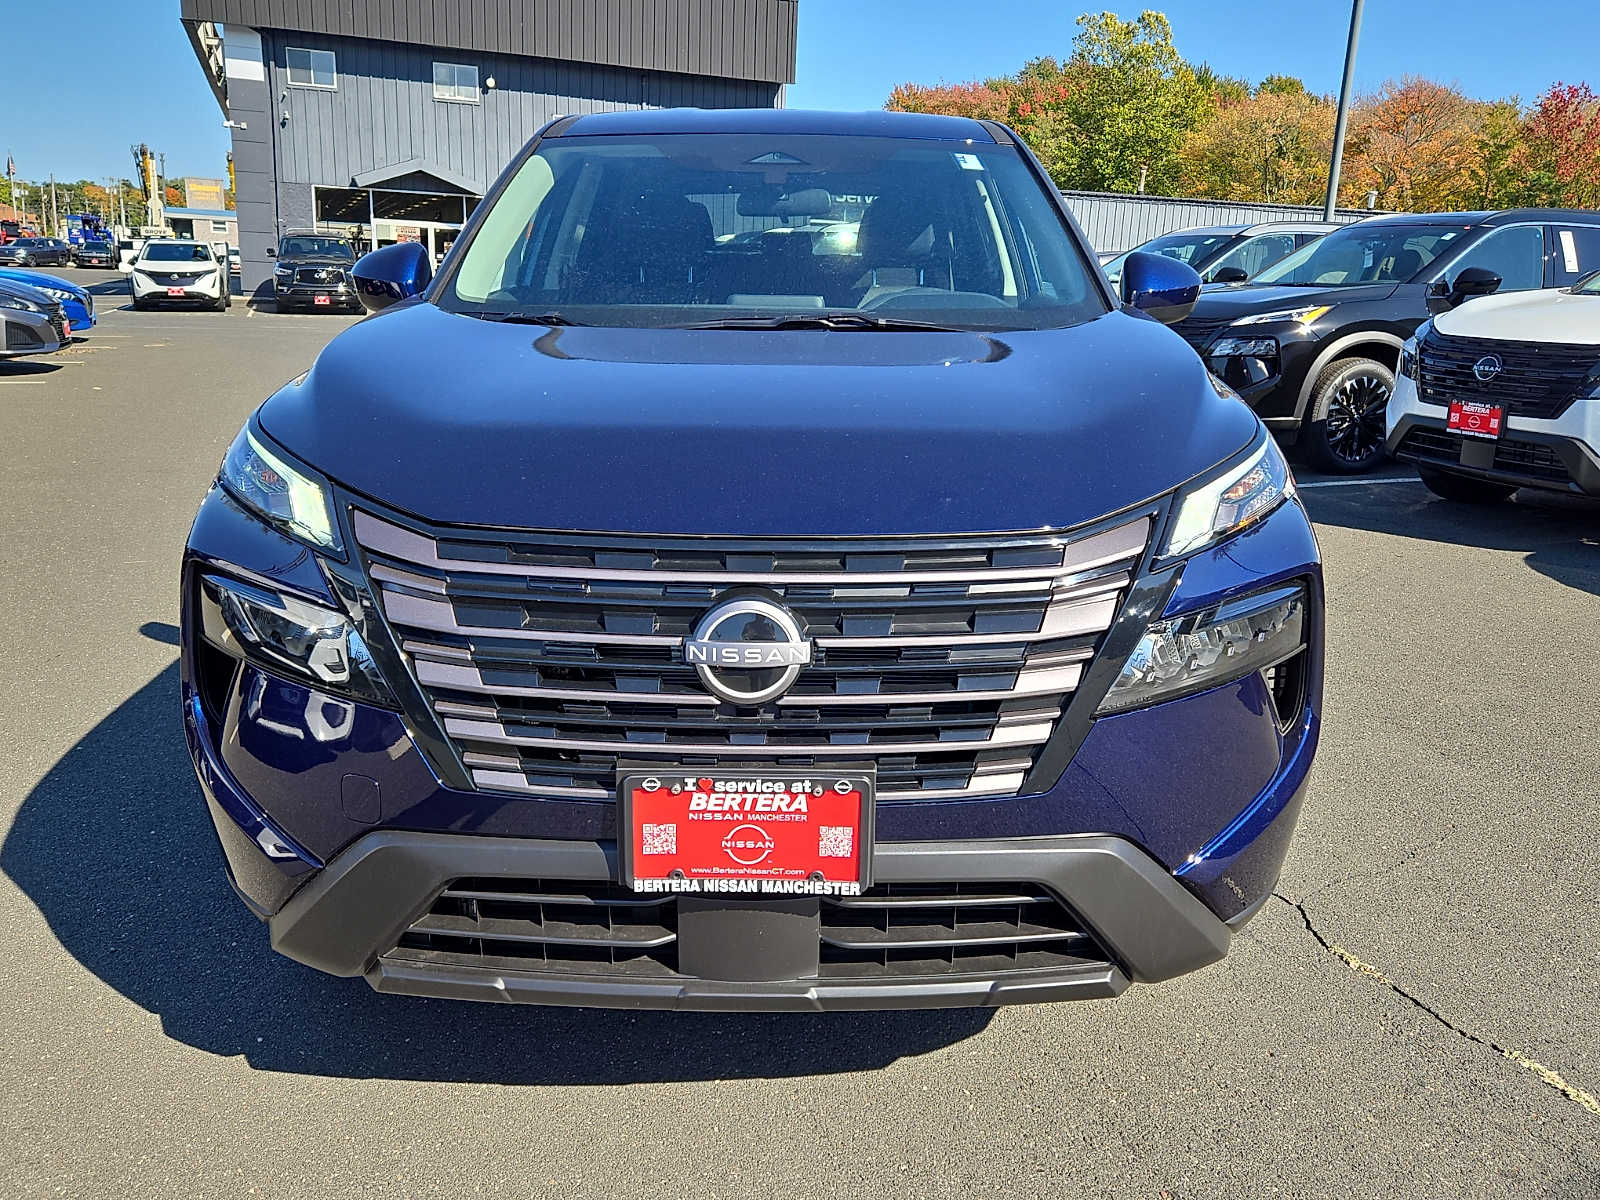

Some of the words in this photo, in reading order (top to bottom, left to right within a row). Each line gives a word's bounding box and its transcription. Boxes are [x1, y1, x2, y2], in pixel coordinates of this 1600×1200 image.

[688, 645, 807, 663] NISSAN
[684, 777, 697, 791] I
[714, 778, 785, 793] service
[790, 779, 812, 793] at
[689, 792, 808, 813] BERTERA
[689, 813, 743, 821] NISSAN
[747, 814, 808, 822] MANCHESTER
[721, 840, 775, 848] NISSAN
[633, 879, 700, 893] BERTERA
[703, 880, 758, 893] NISSAN
[762, 881, 861, 896] MANCHESTER
